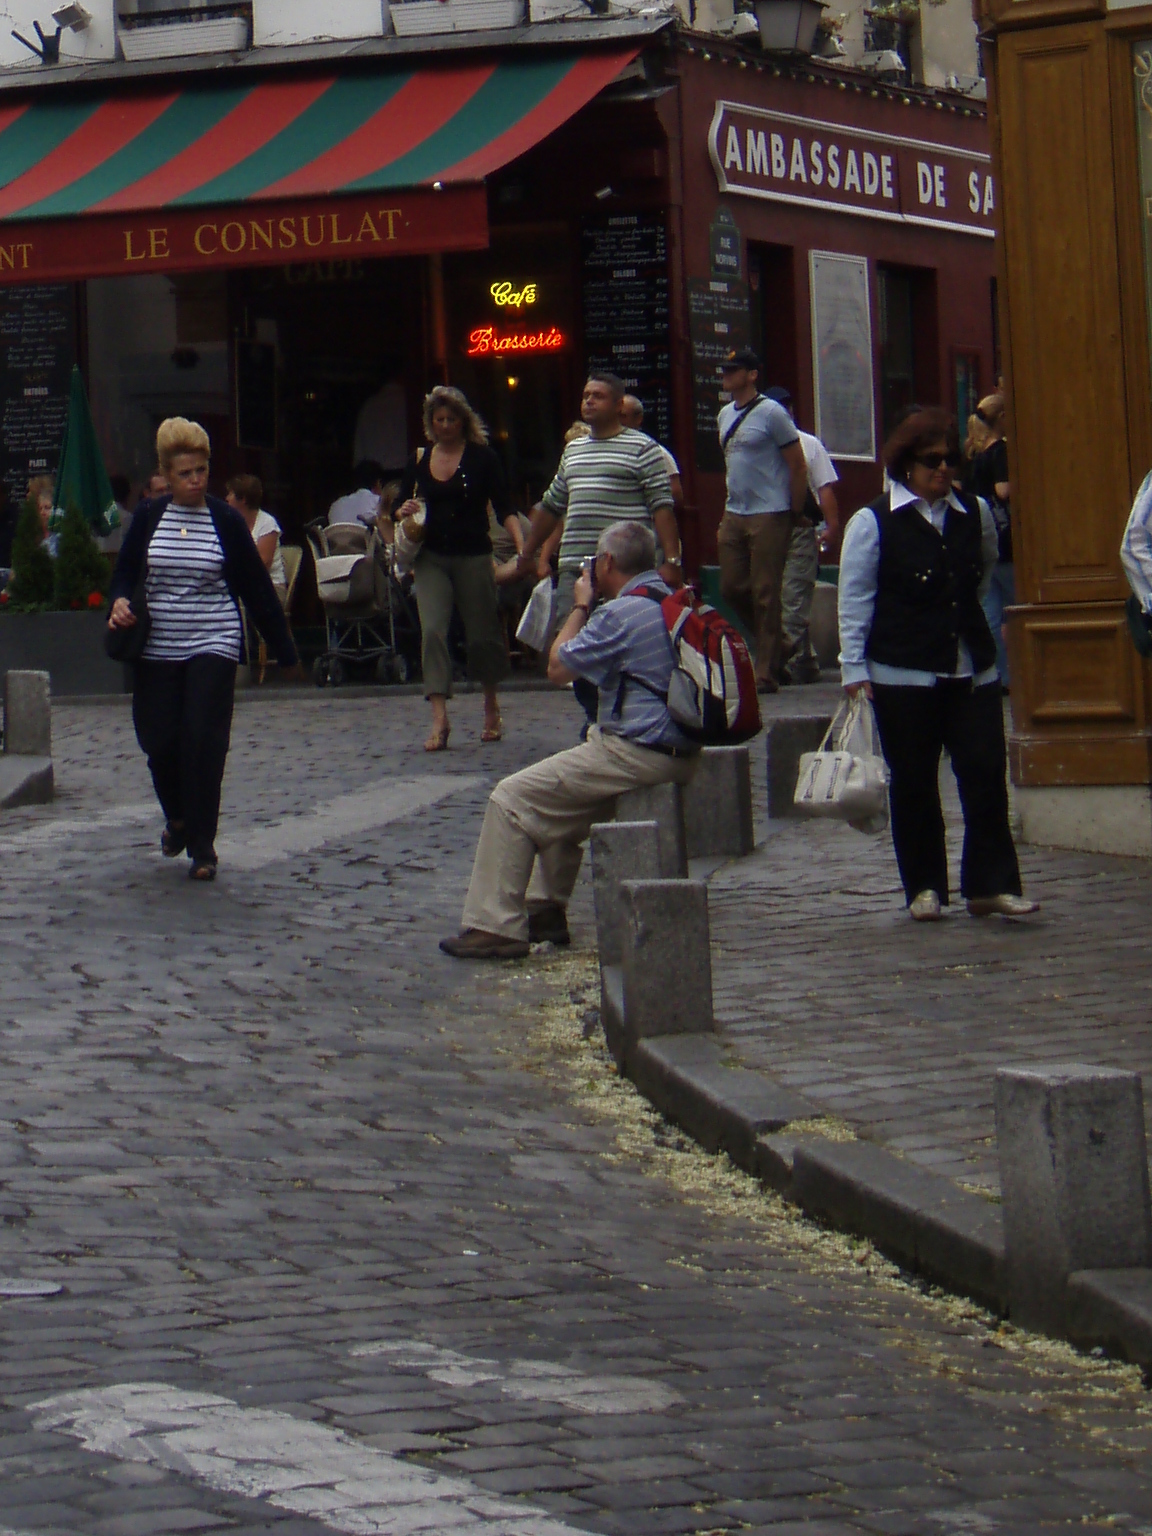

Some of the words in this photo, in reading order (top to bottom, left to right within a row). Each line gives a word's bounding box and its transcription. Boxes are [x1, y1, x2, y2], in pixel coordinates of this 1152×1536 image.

[724, 124, 895, 200] AMBASSADE
[916, 161, 946, 208] DE
[968, 170, 994, 217] SA
[122, 227, 171, 261] LE
[193, 208, 403, 256] CONSULAT
[719, 236, 732, 249] RUE
[490, 281, 537, 308] Café
[468, 326, 562, 354] Brasserie
